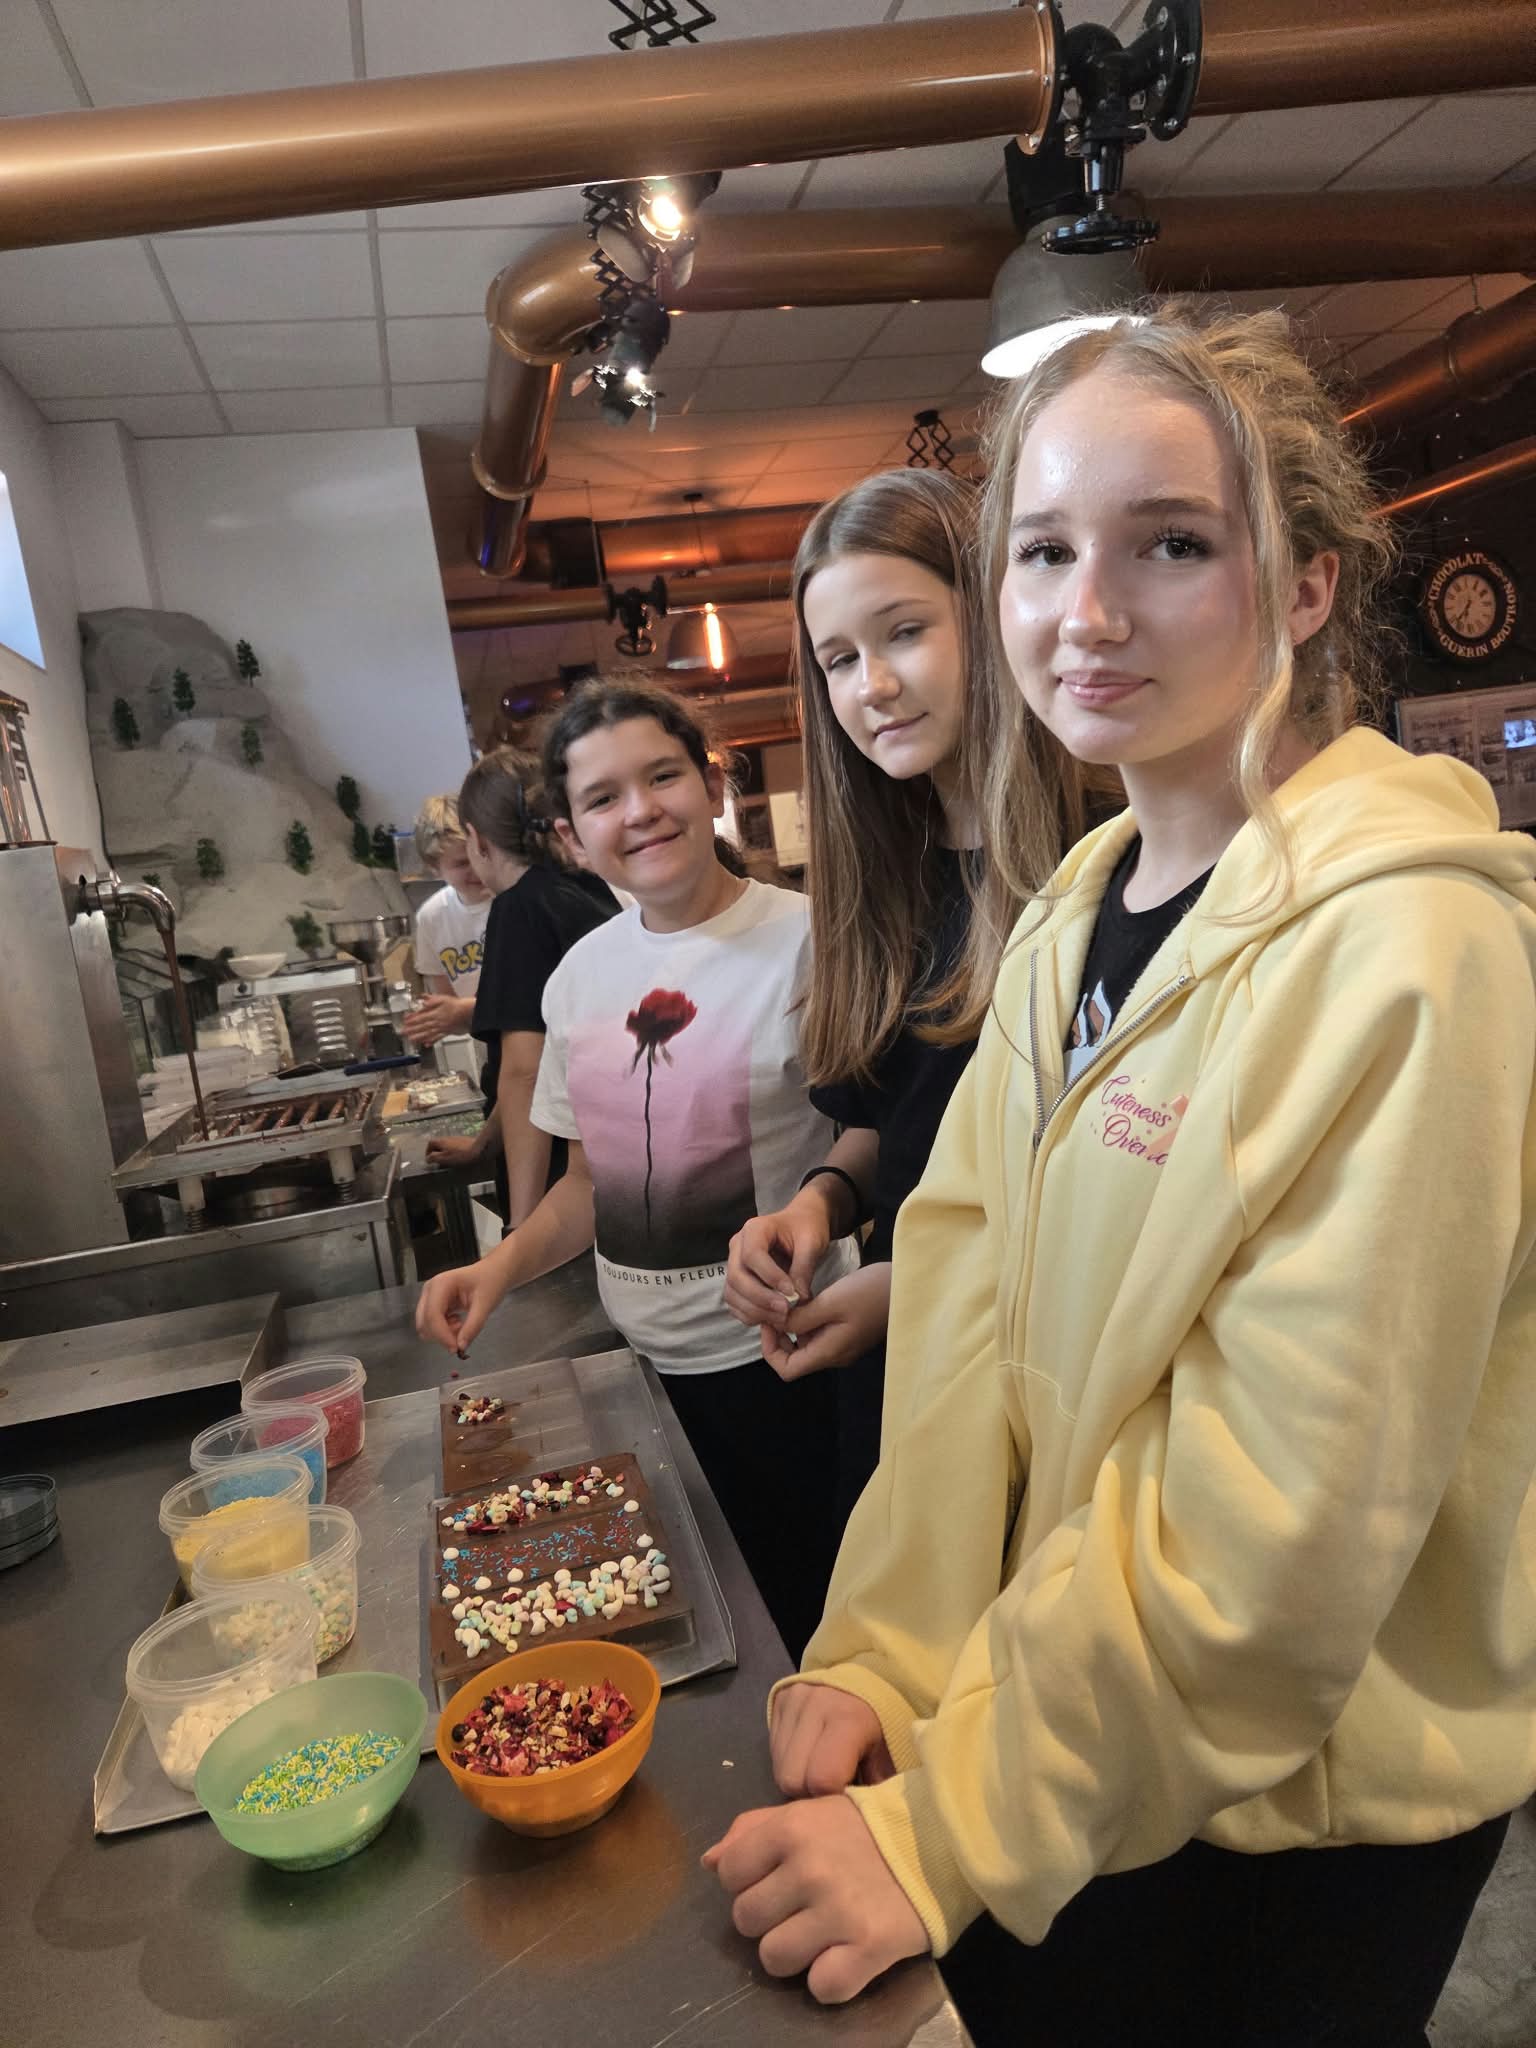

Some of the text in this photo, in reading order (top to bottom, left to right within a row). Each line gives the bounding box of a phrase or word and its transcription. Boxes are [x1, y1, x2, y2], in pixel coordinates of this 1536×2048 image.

[1428, 552, 1485, 600] CHOCOLAT
[1102, 1075, 1172, 1128] Cuteness
[603, 1263, 649, 1285] TOUJOURS
[655, 1275, 672, 1286] EN
